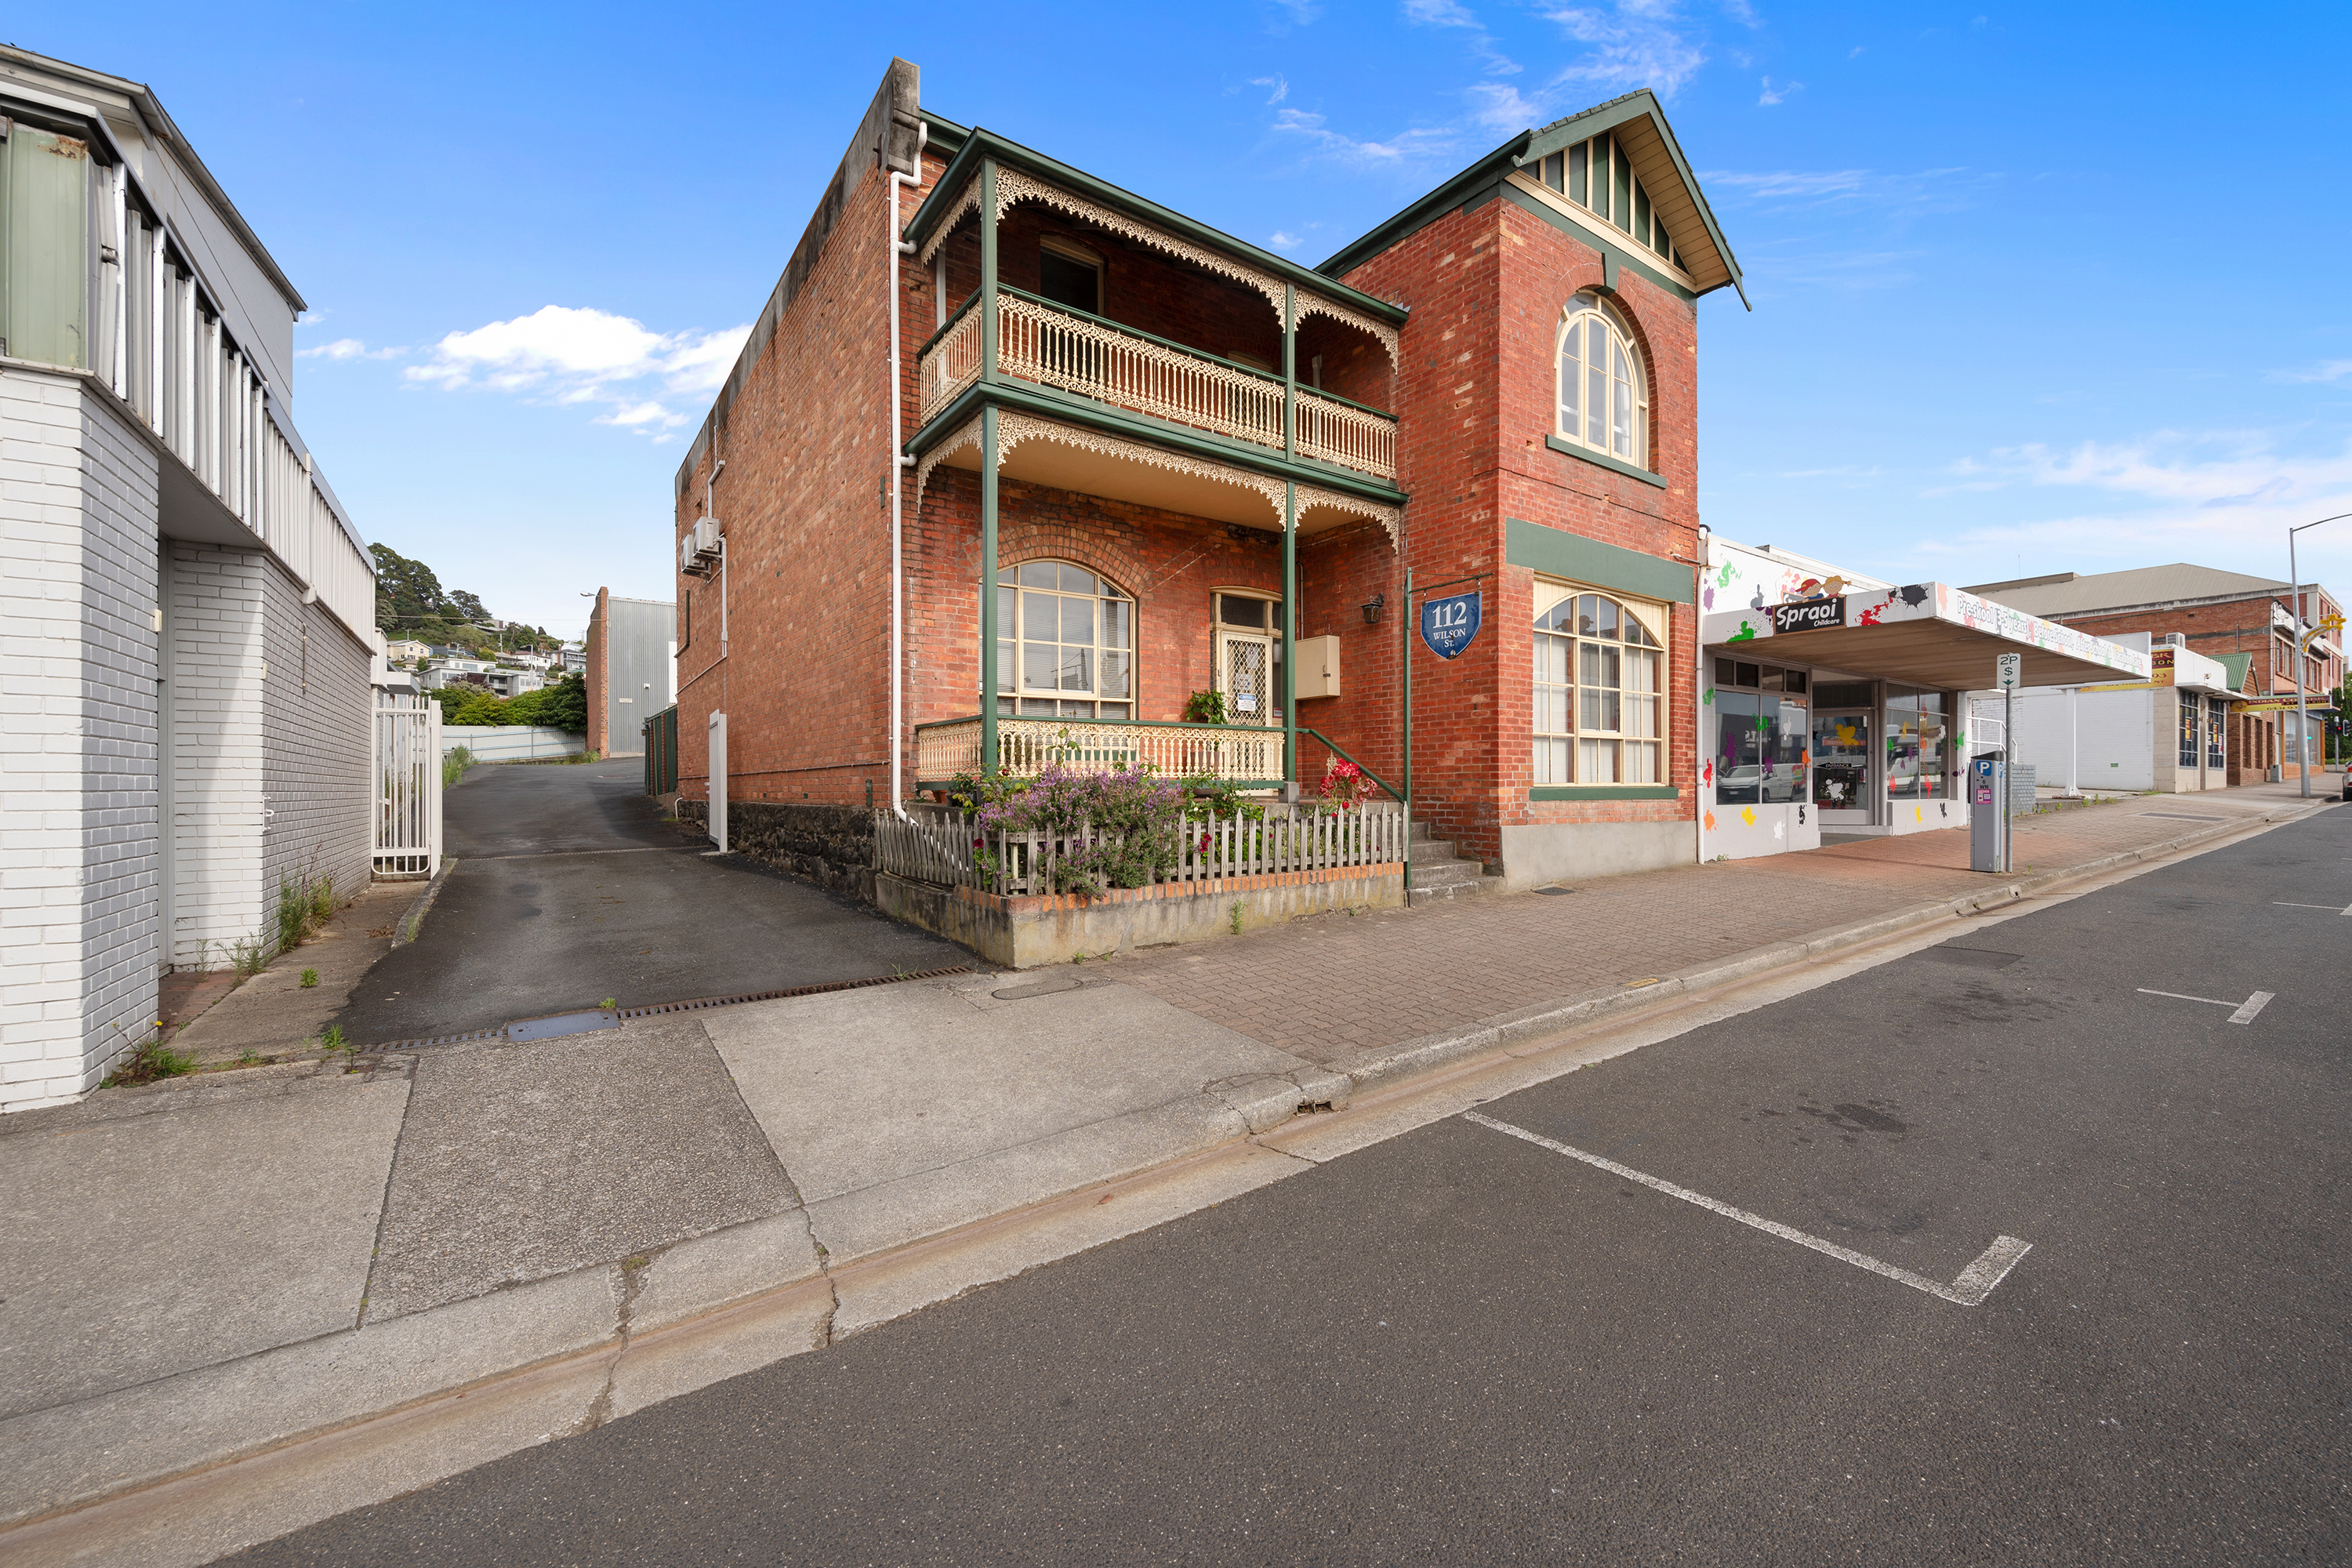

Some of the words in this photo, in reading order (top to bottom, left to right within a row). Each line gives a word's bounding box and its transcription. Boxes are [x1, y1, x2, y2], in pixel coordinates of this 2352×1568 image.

[1432, 601, 1467, 628] 112
[1776, 598, 1837, 630] Spraoi
[1813, 619, 1840, 627] Childcare
[1433, 628, 1467, 641] WILSON
[2033, 620, 2053, 643] Before
[2076, 635, 2090, 653] After
[2090, 639, 2107, 658] School
[2000, 655, 2018, 665] 2P
[2004, 666, 2013, 677] $
[1980, 761, 1991, 774] P
[1998, 764, 2003, 776] P
